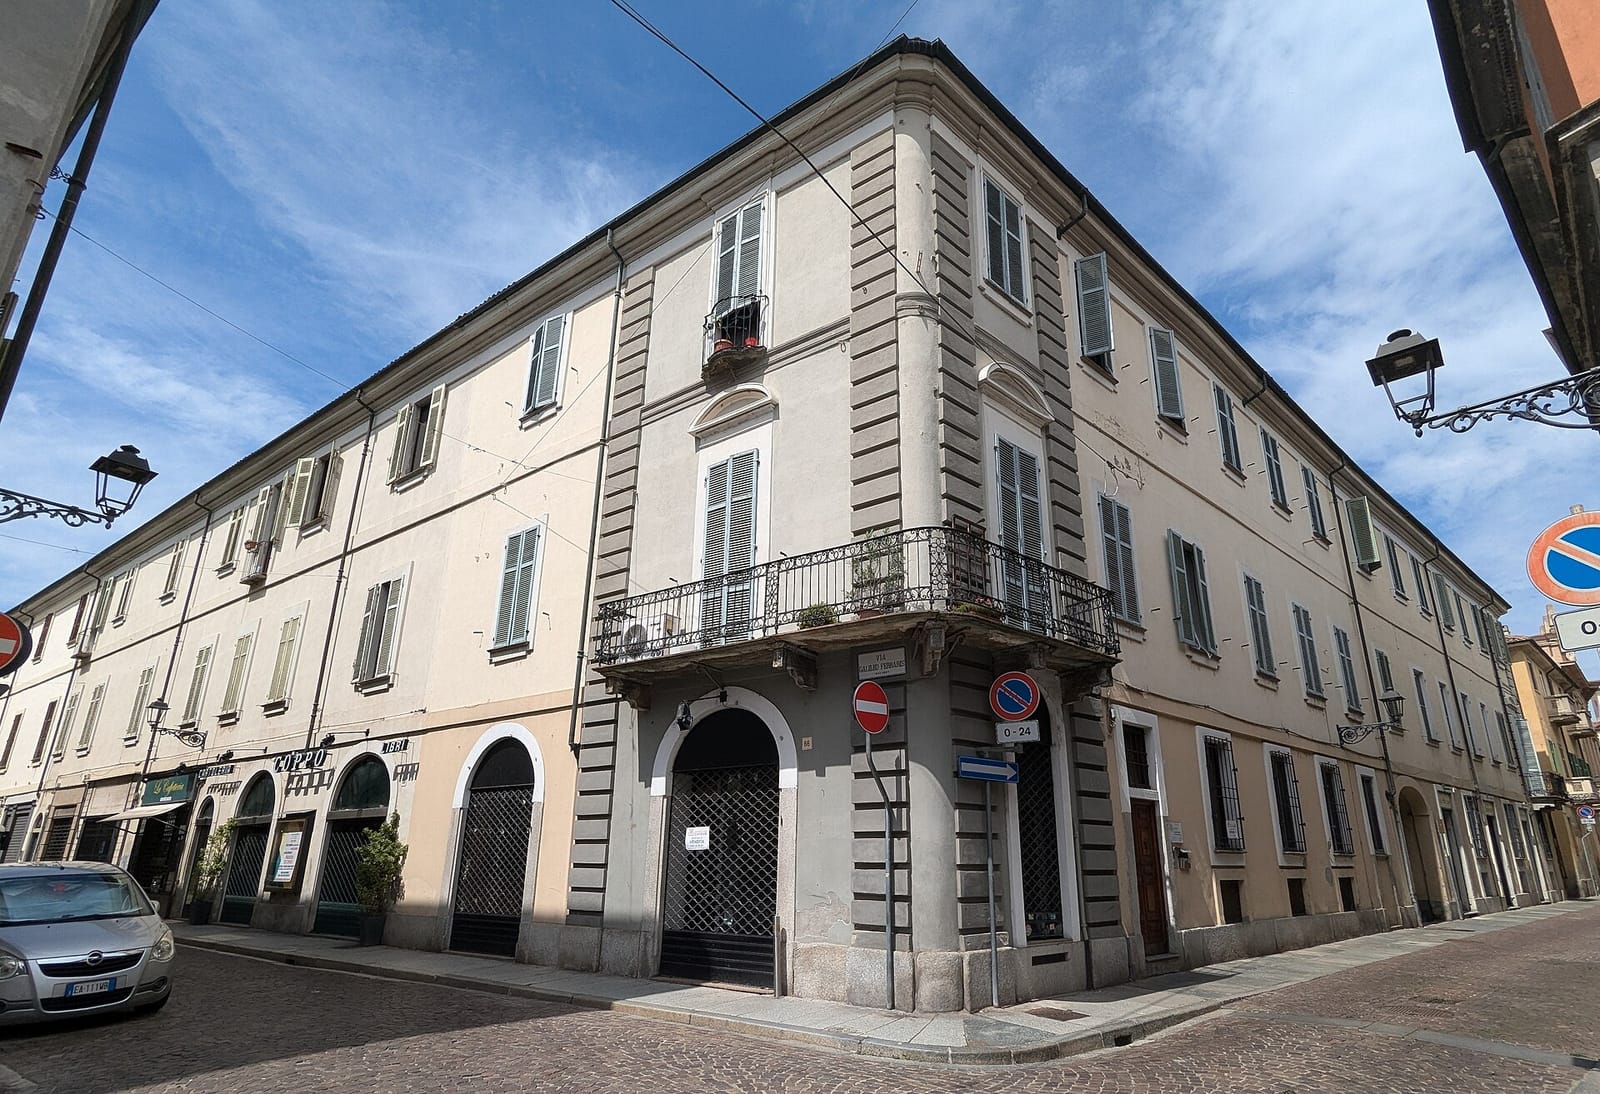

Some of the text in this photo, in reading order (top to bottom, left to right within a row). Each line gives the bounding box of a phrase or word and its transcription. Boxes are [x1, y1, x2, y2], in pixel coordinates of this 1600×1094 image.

[875, 653, 886, 662] VIA
[1018, 726, 1032, 737] 24
[273, 748, 324, 772] COPPO
